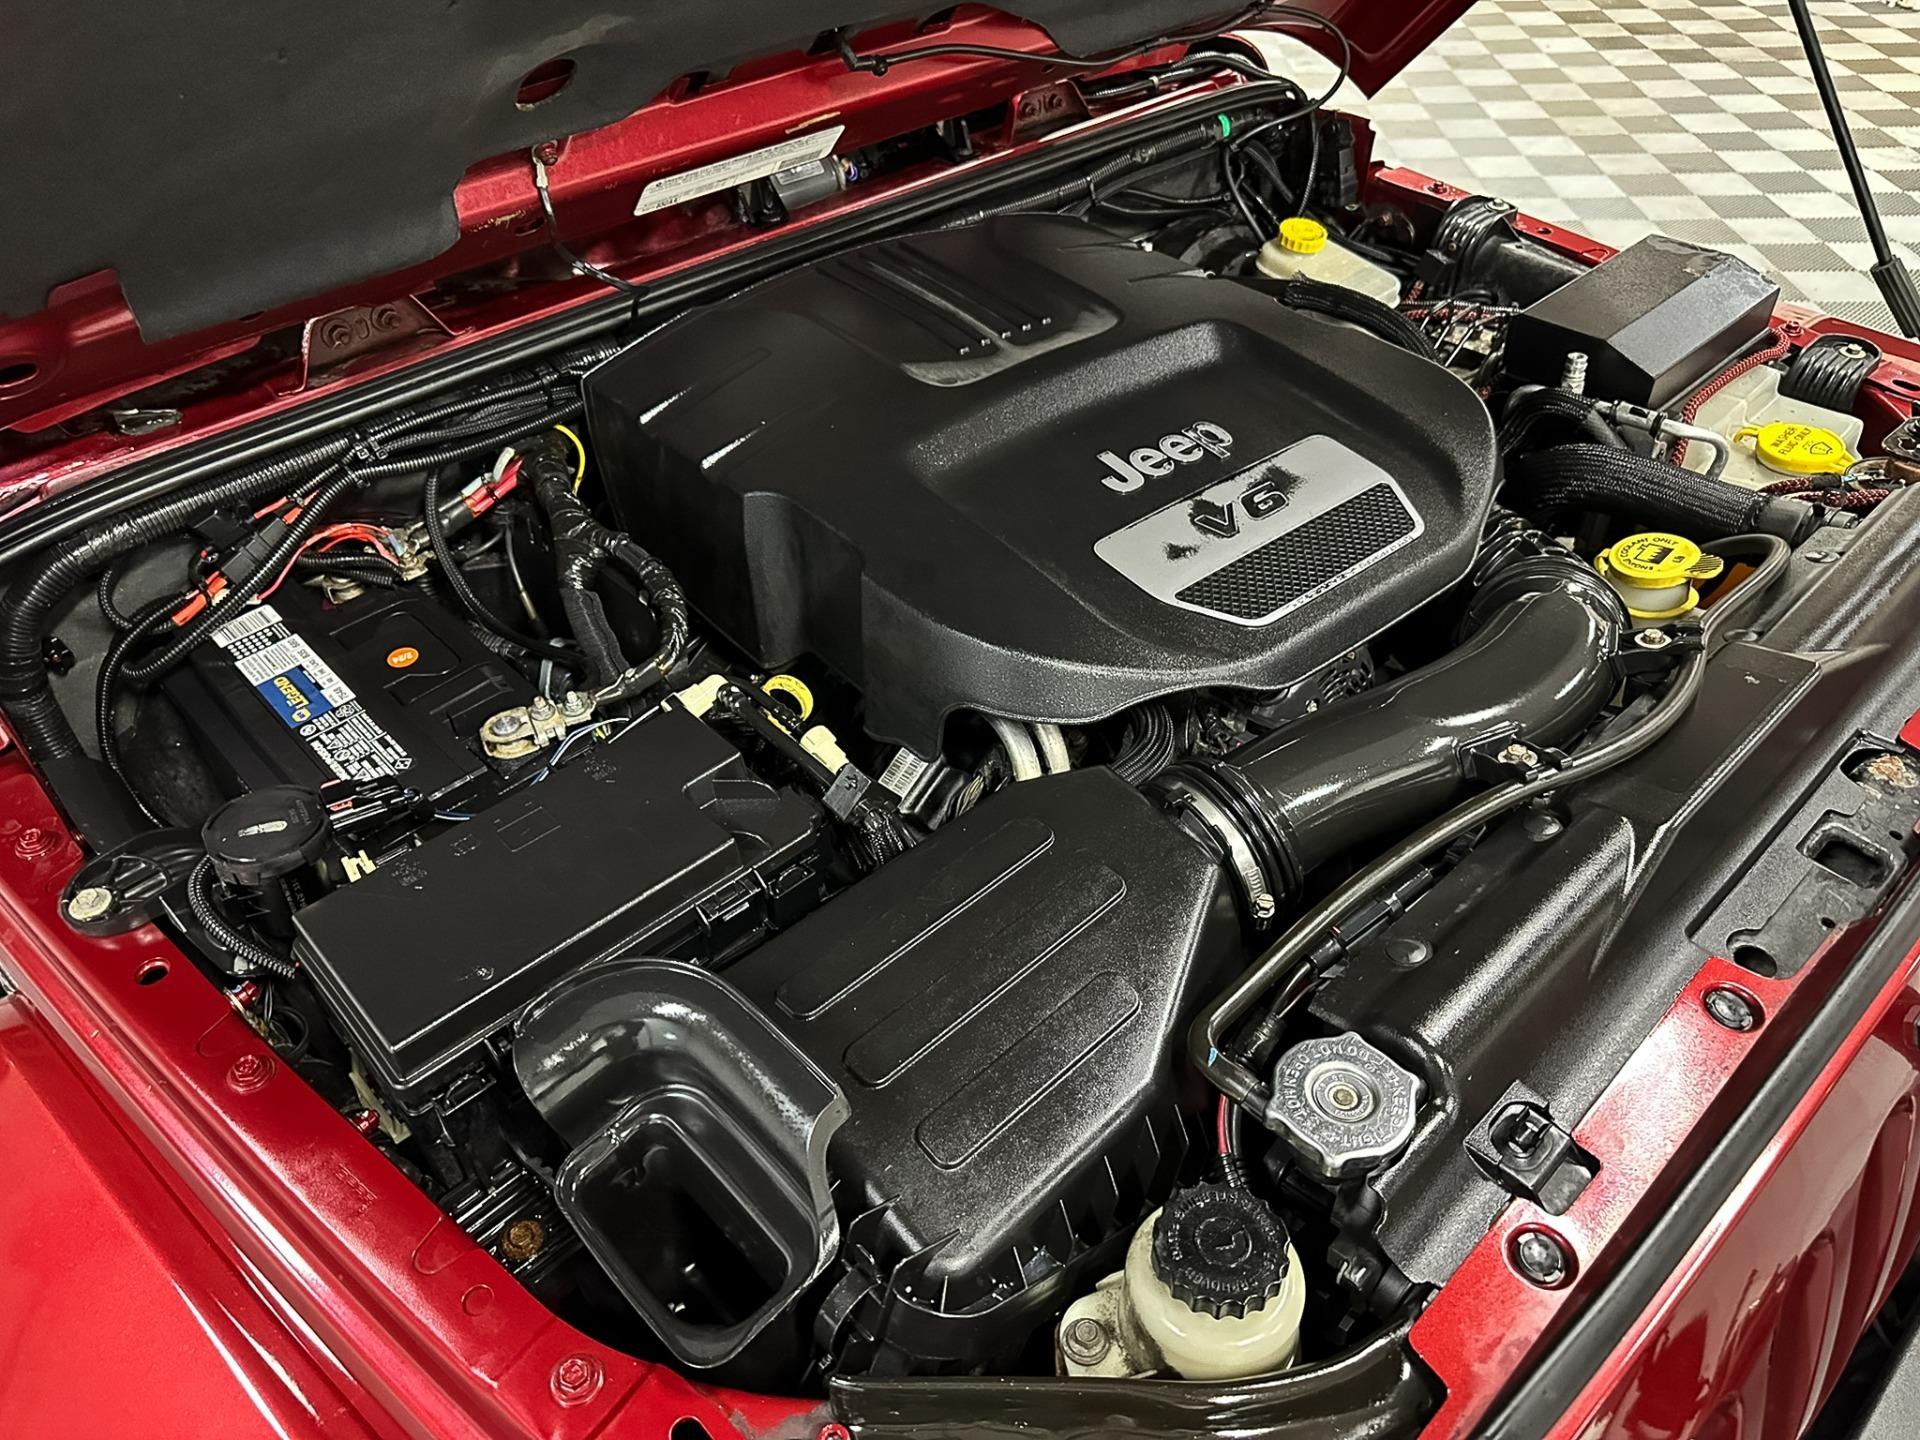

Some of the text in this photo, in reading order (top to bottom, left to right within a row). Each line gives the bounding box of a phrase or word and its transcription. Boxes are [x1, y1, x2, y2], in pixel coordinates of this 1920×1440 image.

[1096, 421, 1233, 494] Jeep
[1194, 480, 1290, 538] V6
[1620, 537, 1679, 558] COOLANT ONLY
[273, 675, 309, 709] LEGEND
